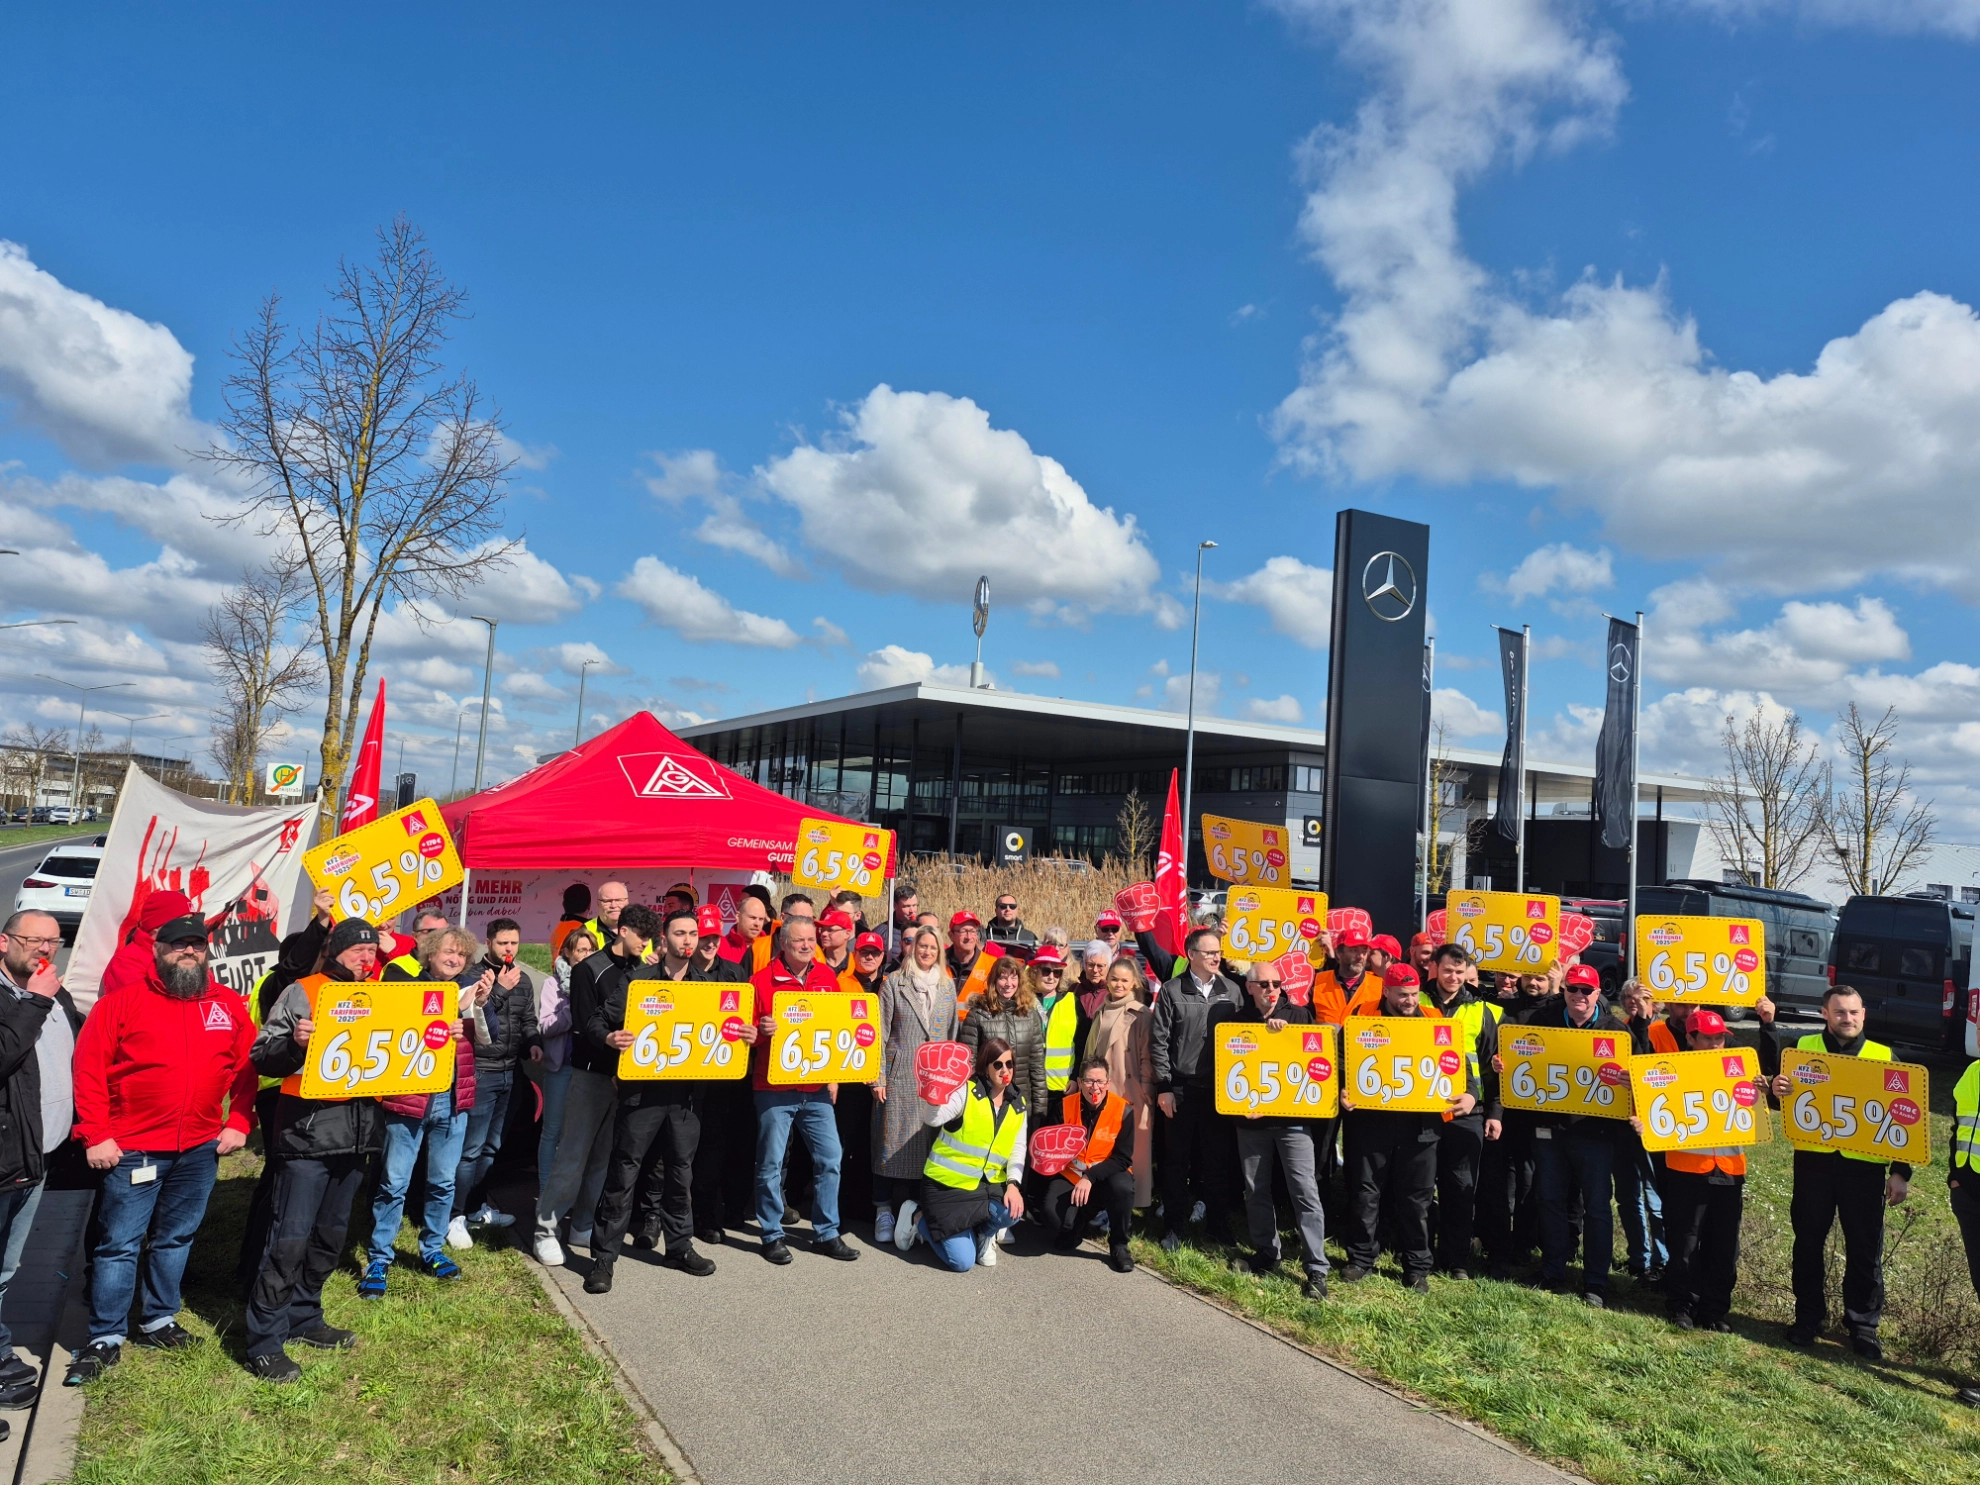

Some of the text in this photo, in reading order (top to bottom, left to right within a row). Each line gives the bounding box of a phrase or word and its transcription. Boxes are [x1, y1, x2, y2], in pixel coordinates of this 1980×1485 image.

[728, 837, 792, 850] GEMEINSAM
[323, 854, 360, 874] TARIFRUNDE
[326, 857, 338, 865] KFZ
[335, 866, 350, 876] 2025
[475, 880, 523, 894] MEHR
[487, 907, 521, 916] dabei!
[1793, 1071, 1829, 1080] TARIFRUNDE
